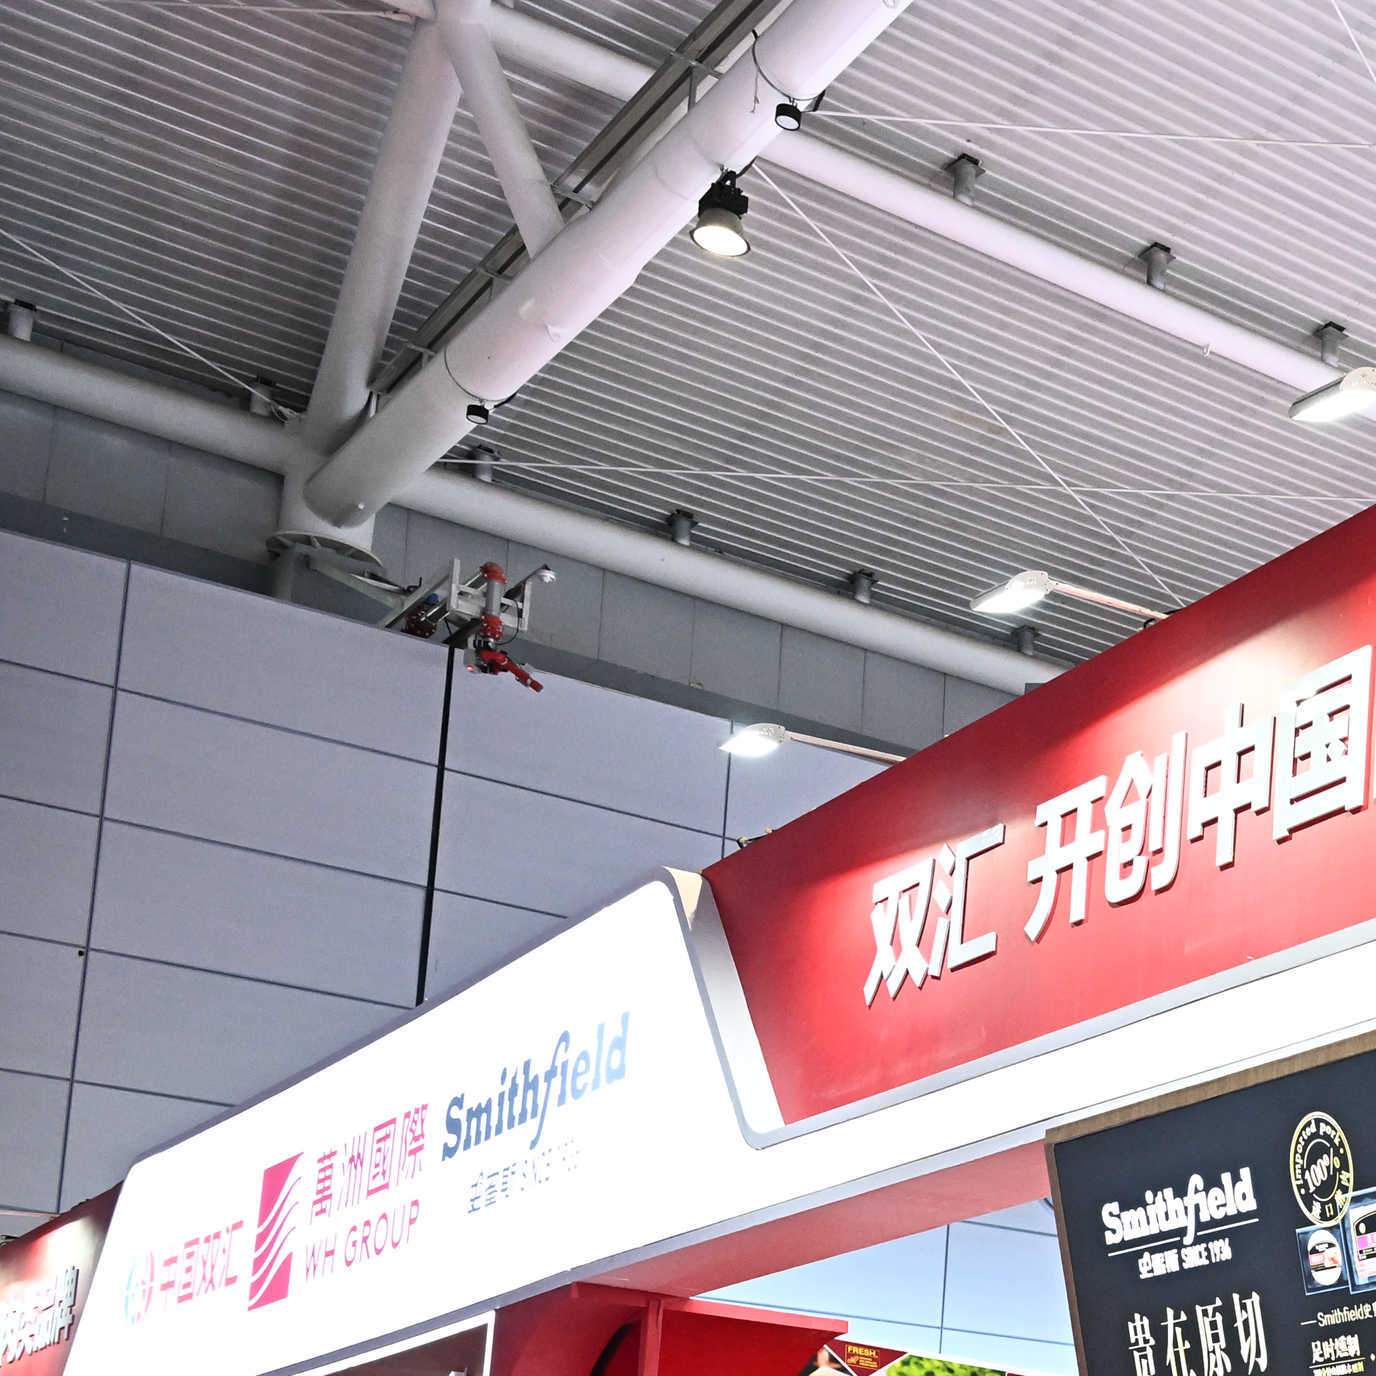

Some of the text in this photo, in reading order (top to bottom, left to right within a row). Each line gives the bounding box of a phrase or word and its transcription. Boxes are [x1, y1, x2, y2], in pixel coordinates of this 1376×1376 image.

[863, 824, 1006, 1007] 双汇
[441, 1011, 630, 1162] Smithfield
[309, 1103, 428, 1225] 萬洲國際
[1101, 1167, 1257, 1245] Smithfield
[305, 1200, 420, 1281] WH GROUP
